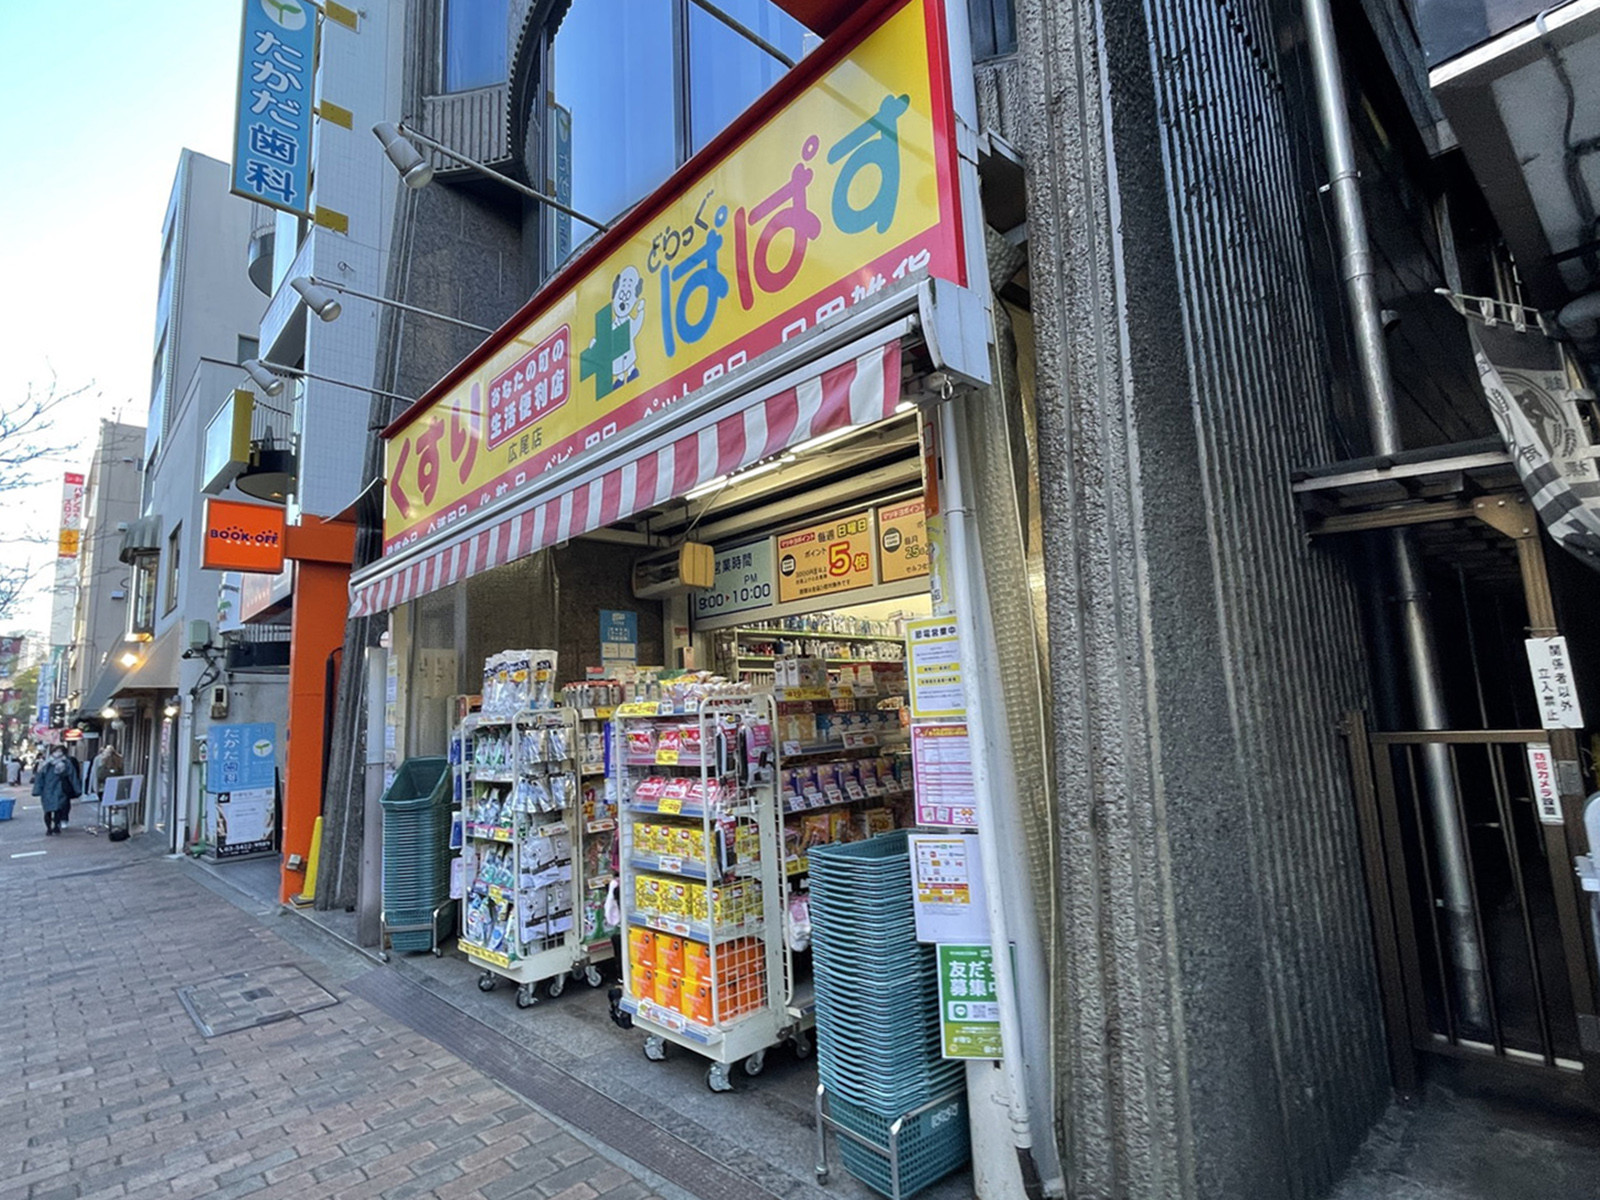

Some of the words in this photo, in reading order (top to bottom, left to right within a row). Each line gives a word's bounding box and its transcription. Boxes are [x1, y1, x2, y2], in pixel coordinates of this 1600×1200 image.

[246, 30, 303, 204] たかだ歯科
[660, 93, 910, 358] ぱぱす
[490, 368, 565, 440] 生活便利店
[390, 381, 482, 520] くすり
[507, 426, 543, 464] 広尾店
[836, 518, 868, 538] 日曜日
[743, 573, 758, 585] PM
[829, 540, 852, 577] 5
[732, 583, 771, 603] 10:00
[1537, 667, 1560, 722] 立入禁止
[1548, 644, 1573, 712] 関係者以外
